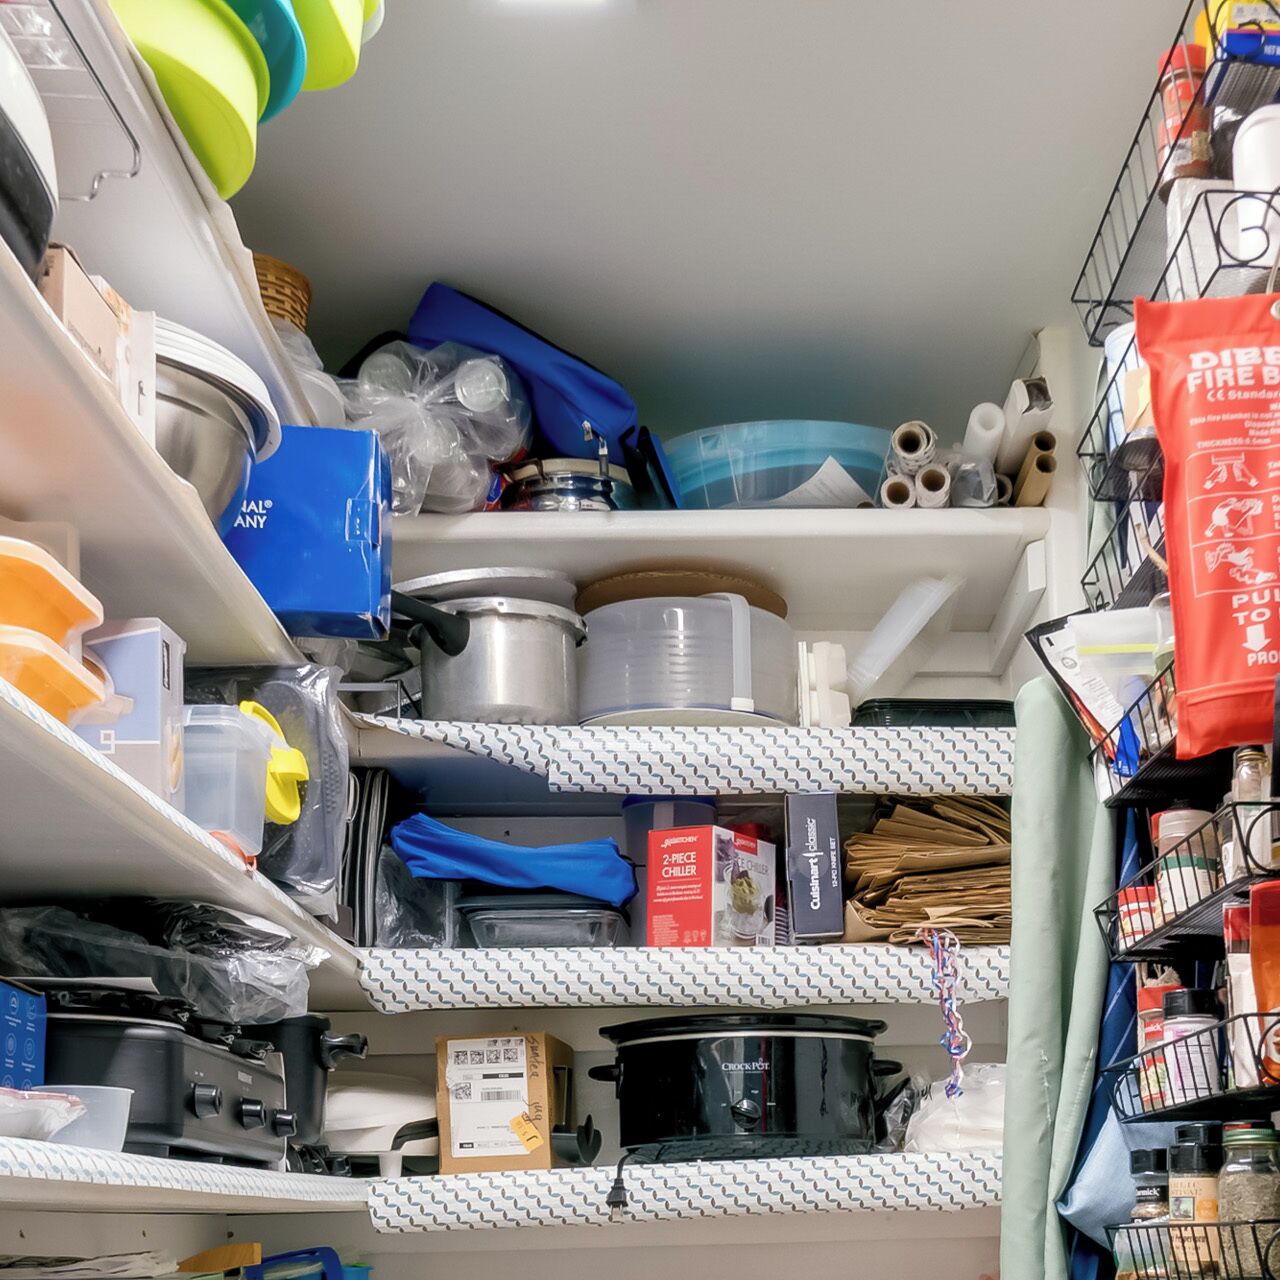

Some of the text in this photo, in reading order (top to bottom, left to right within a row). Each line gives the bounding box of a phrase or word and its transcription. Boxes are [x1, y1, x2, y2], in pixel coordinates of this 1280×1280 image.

[1186, 366, 1256, 395] FIRE
[1232, 607, 1271, 625] TO
[662, 852, 697, 864] 2-PIECE
[661, 865, 697, 878] CHILLER
[808, 857, 821, 910] Cuisinart
